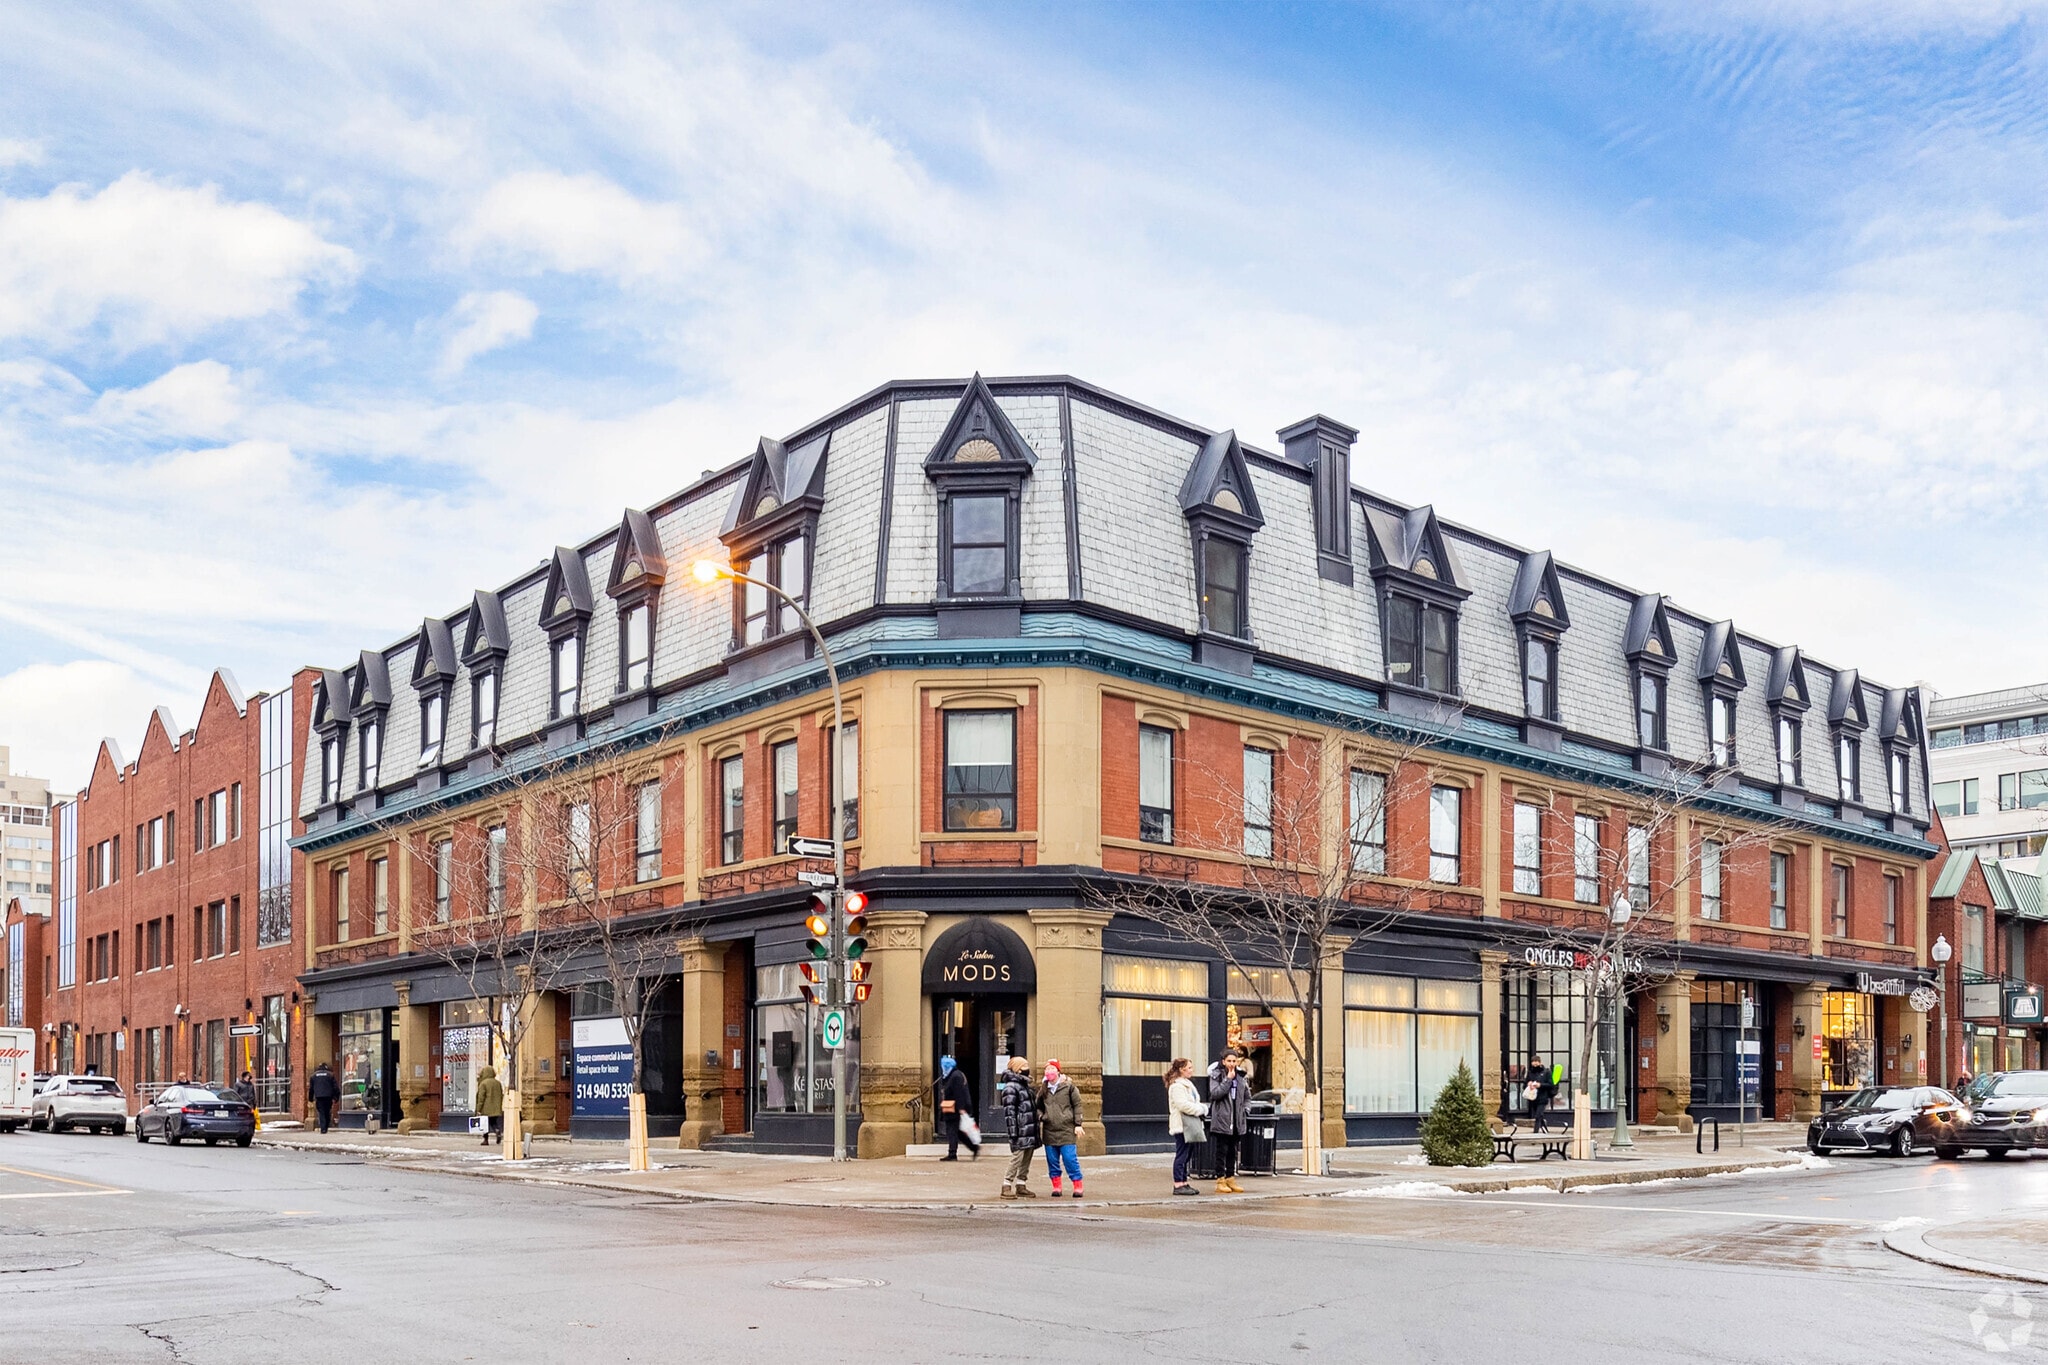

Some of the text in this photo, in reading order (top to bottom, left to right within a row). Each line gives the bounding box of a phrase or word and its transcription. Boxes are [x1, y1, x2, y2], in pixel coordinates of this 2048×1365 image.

[805, 874, 828, 882] GREENE
[970, 949, 995, 959] Salon
[1525, 947, 1574, 967] ONGLES
[944, 964, 1010, 981] MODS
[577, 1054, 591, 1064] Espace
[592, 1052, 616, 1061] commercial
[621, 1051, 633, 1060] louer
[577, 1065, 588, 1074] Retail
[589, 1066, 600, 1075] space
[608, 1064, 619, 1073] lease
[577, 1083, 633, 1098] 514 940 5330
